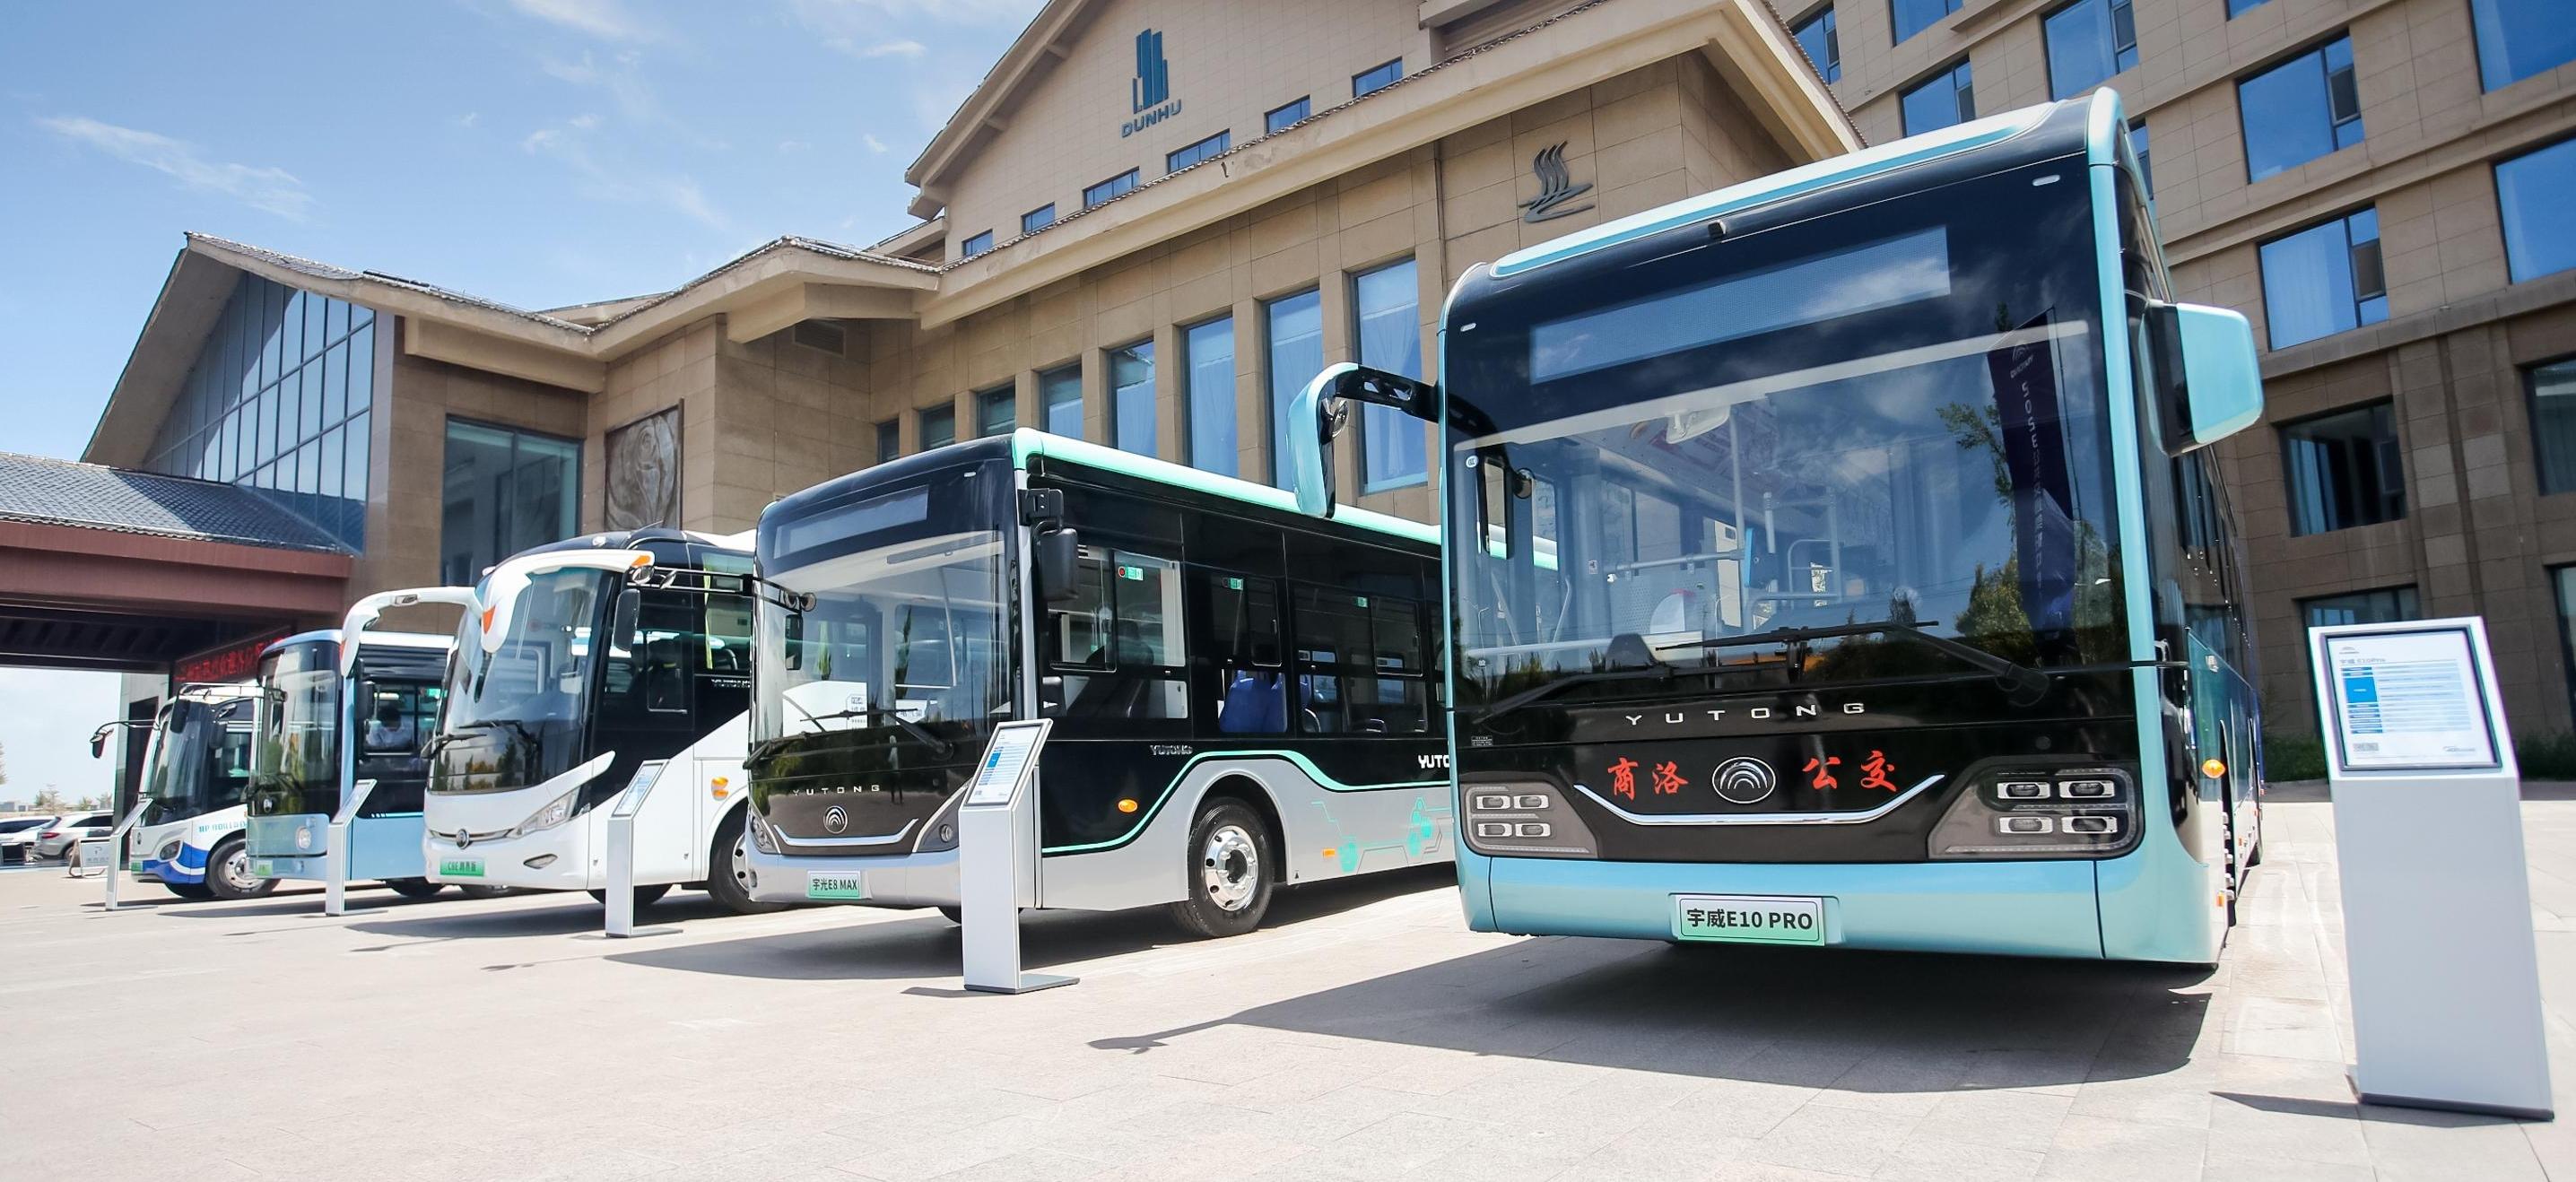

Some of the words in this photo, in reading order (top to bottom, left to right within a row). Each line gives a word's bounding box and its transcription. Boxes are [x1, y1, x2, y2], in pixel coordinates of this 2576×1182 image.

[1121, 99, 1181, 138] DUNHU
[1625, 703, 1865, 726] YUTONG
[1607, 757, 1688, 801] 商洛
[1803, 751, 1897, 792] 公交
[793, 785, 880, 796] YUTONG
[813, 878, 838, 891] 宇光E8
[840, 879, 857, 890] MAX
[1686, 908, 1763, 928] 宇威E10
[1769, 912, 1813, 930] PRO
